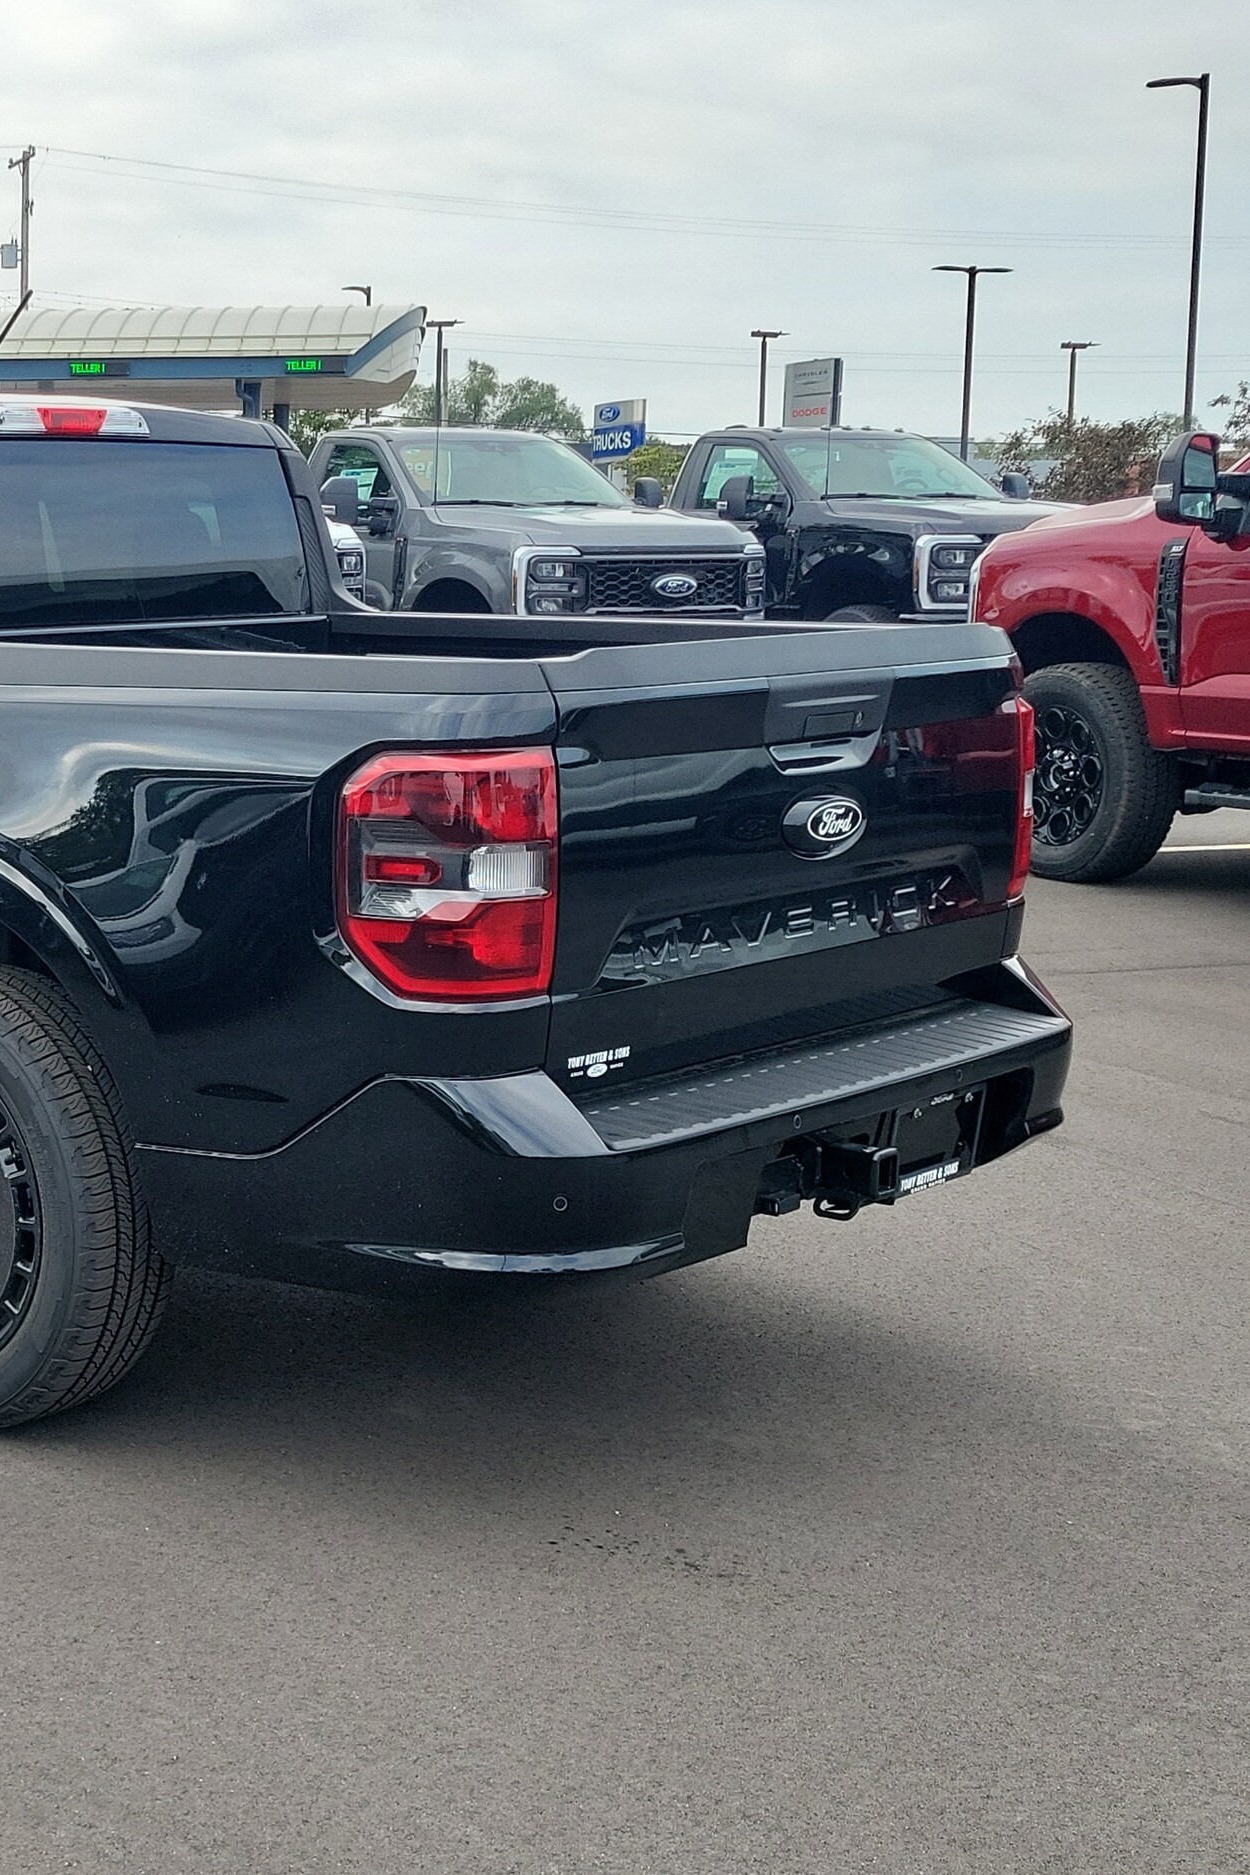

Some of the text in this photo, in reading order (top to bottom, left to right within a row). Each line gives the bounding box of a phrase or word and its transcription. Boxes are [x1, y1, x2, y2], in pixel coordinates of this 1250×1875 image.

[70, 363, 100, 374] TELLER
[286, 360, 316, 371] TELLER
[792, 407, 827, 417] DODGE
[593, 431, 631, 451] TRUCKS
[633, 875, 956, 969] MAVERICK
